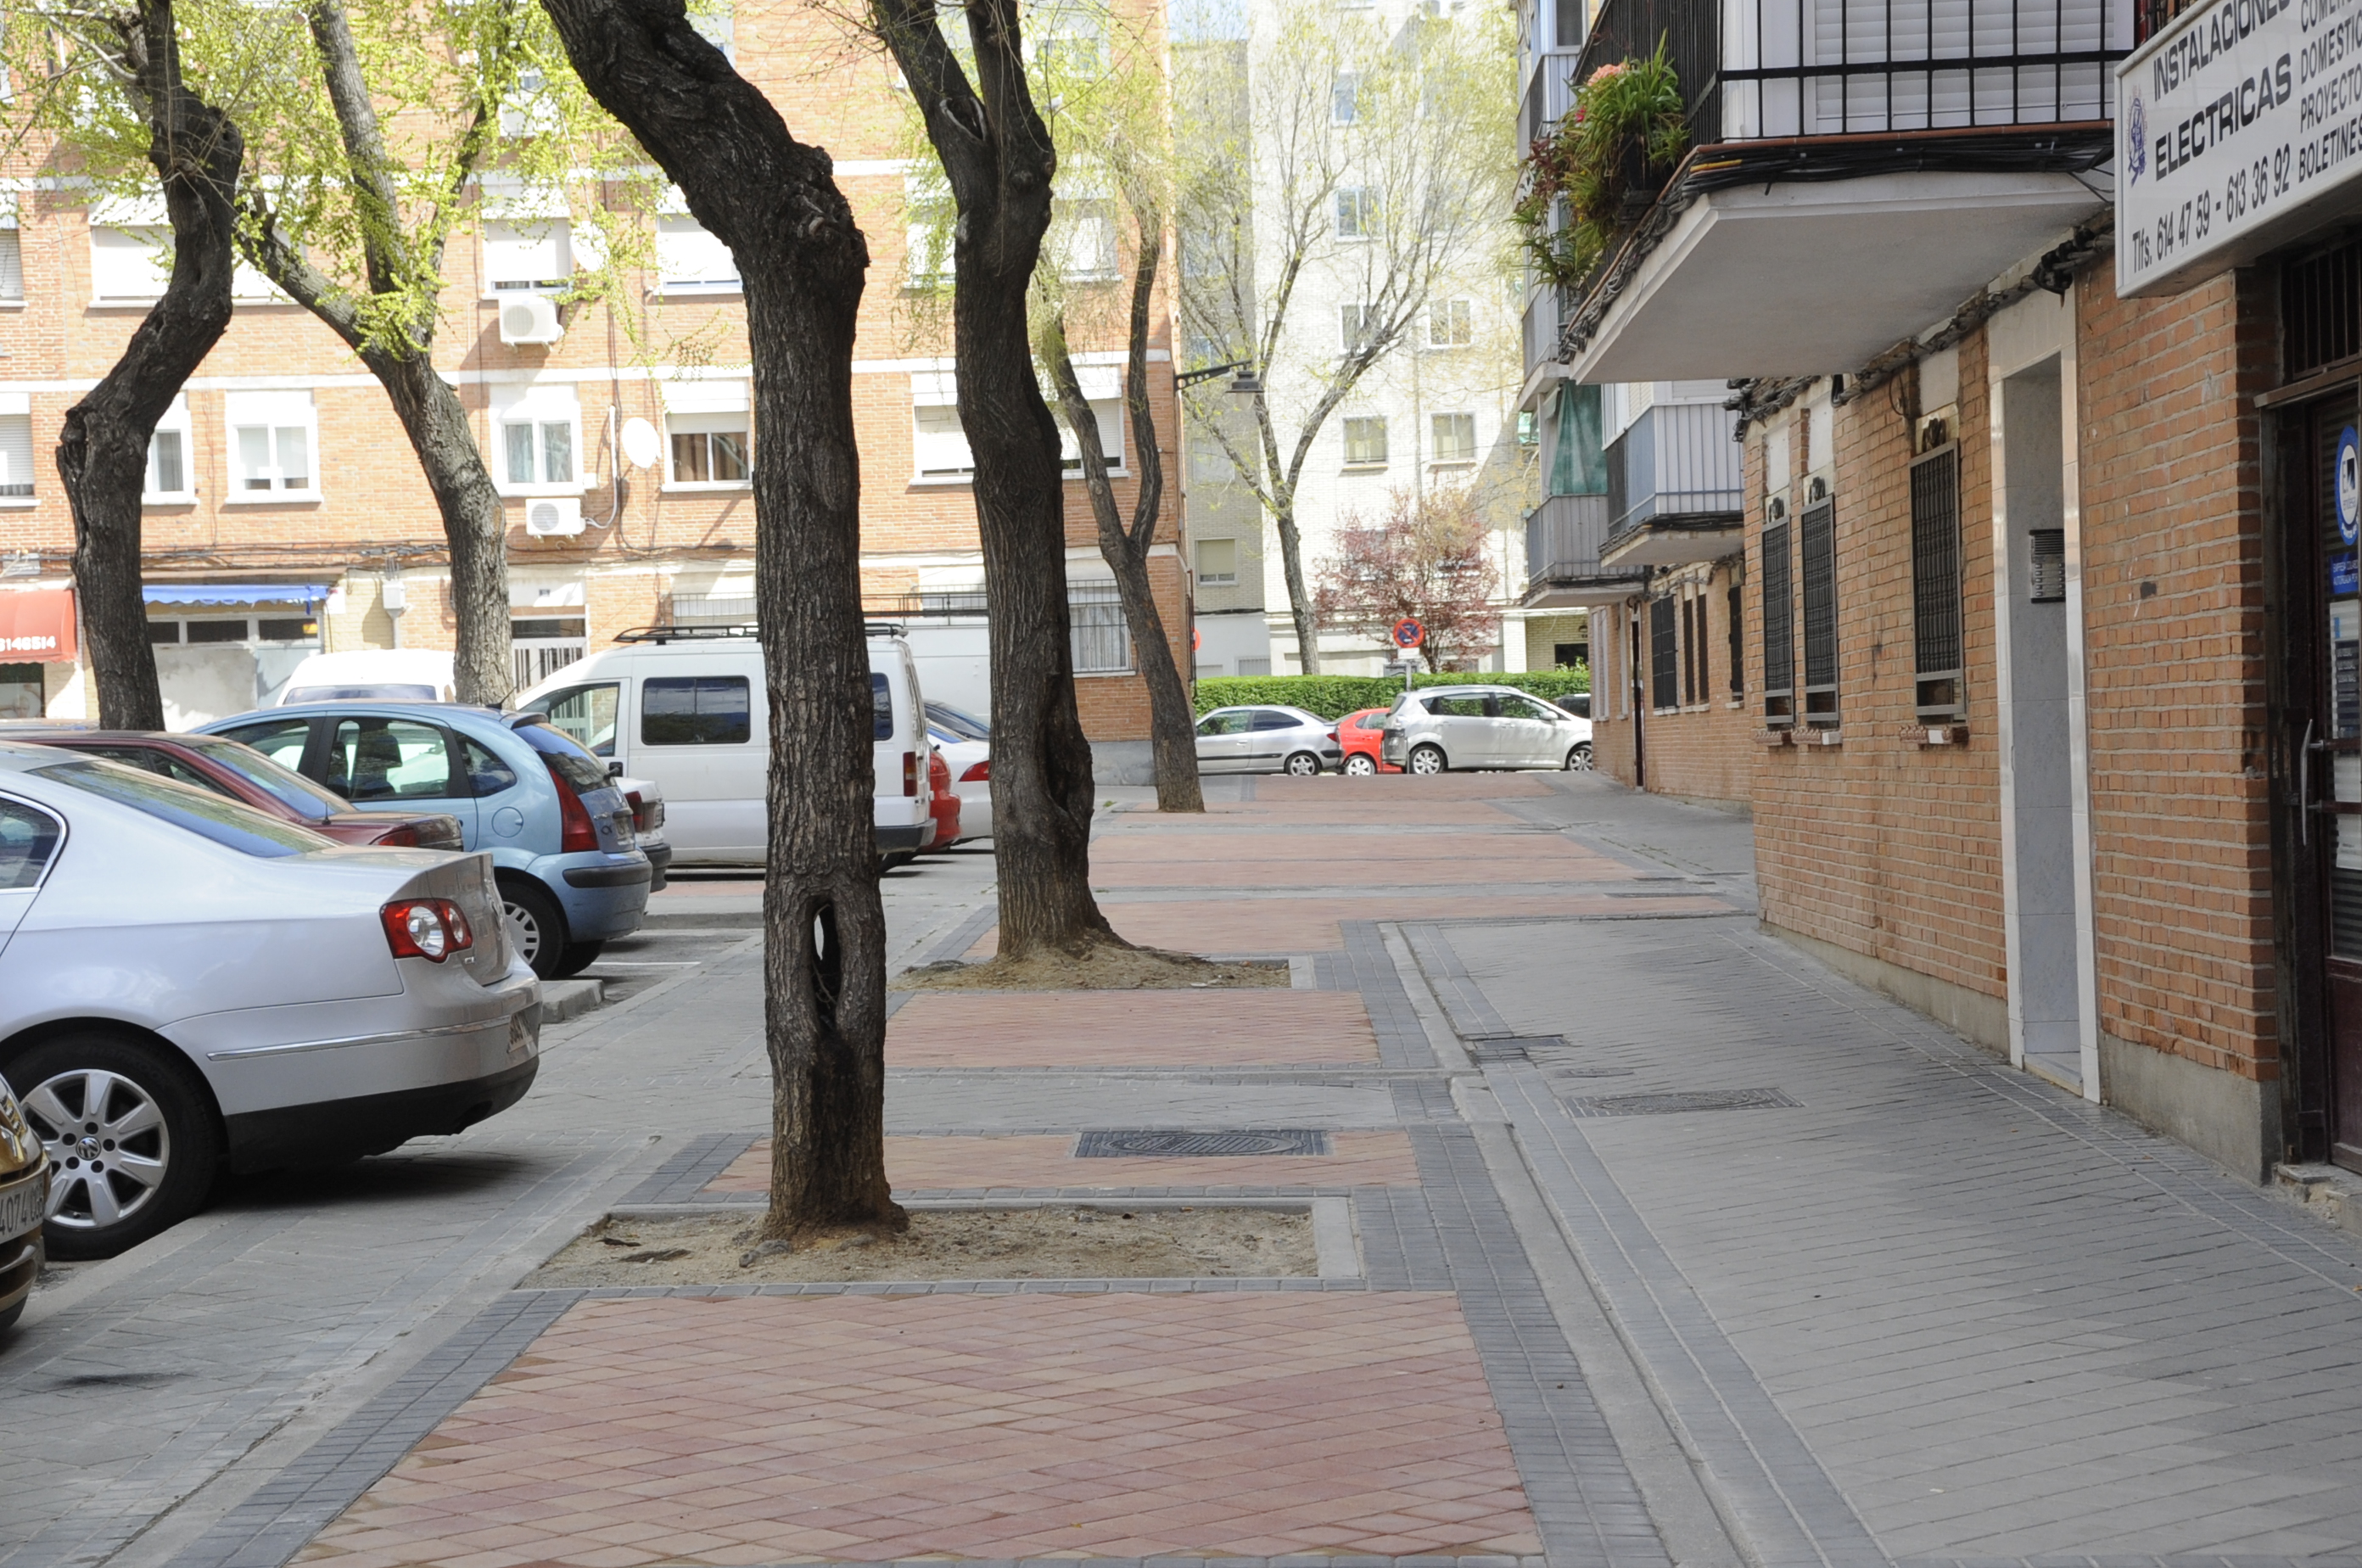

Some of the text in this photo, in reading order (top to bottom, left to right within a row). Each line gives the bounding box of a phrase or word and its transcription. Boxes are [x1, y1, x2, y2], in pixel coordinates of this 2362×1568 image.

[2153, 0, 2290, 102] INSTALACION
[2300, 63, 2362, 133] PROYECTO
[2156, 53, 2291, 182] ELECTRICAS
[2298, 112, 2362, 183] BOLETINES
[2132, 227, 2152, 273] Tlfs.
[2157, 210, 2174, 260] 614
[2179, 200, 2192, 248] 47
[2196, 189, 2210, 239] 59
[2226, 168, 2246, 222] 613
[2252, 155, 2268, 209] 36
[2274, 143, 2290, 198] 92
